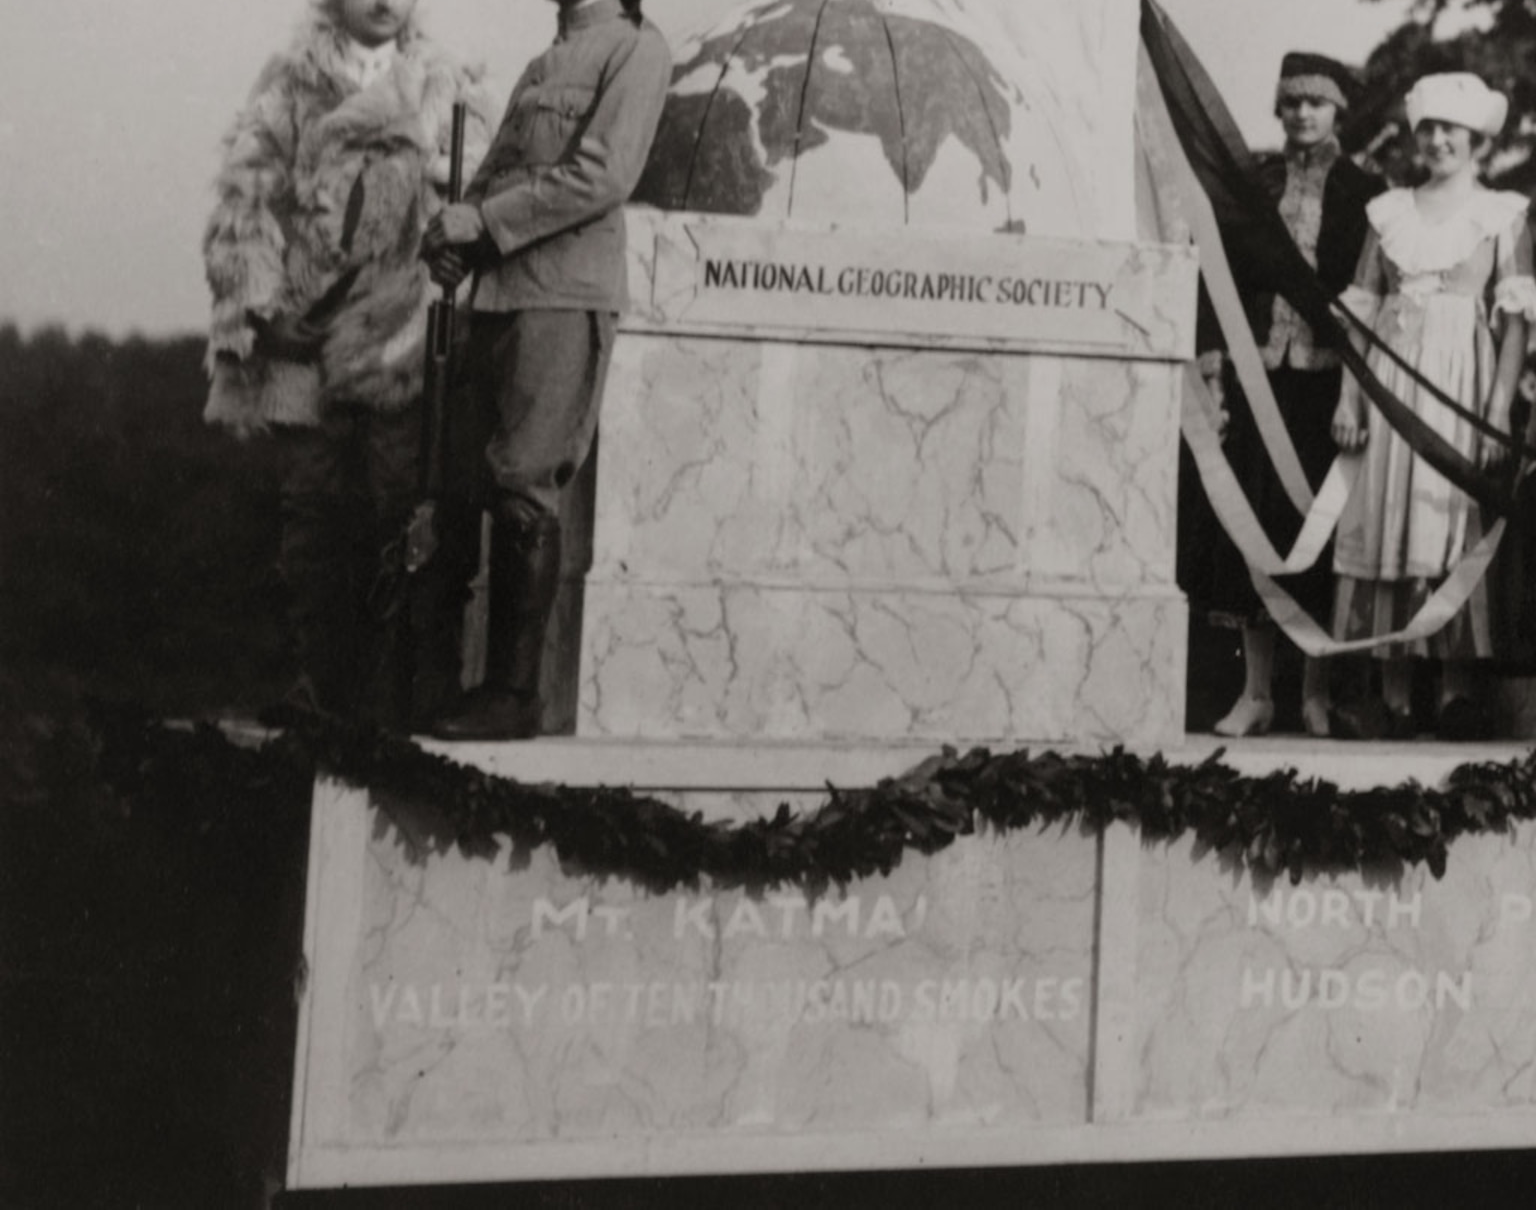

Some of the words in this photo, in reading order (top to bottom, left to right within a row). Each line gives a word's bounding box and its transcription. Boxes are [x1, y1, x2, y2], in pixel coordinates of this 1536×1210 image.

[704, 258, 834, 294] NATIONAL
[837, 267, 993, 304] GEOGRAPHIC
[996, 278, 1114, 310] SOCIETY
[1246, 888, 1424, 931] NORTH
[368, 979, 550, 1029] VALLEY
[559, 981, 610, 1026] OF
[623, 980, 695, 1027] TEN
[912, 975, 1084, 1024] SMOKES
[1239, 966, 1474, 1012] HUDSON
